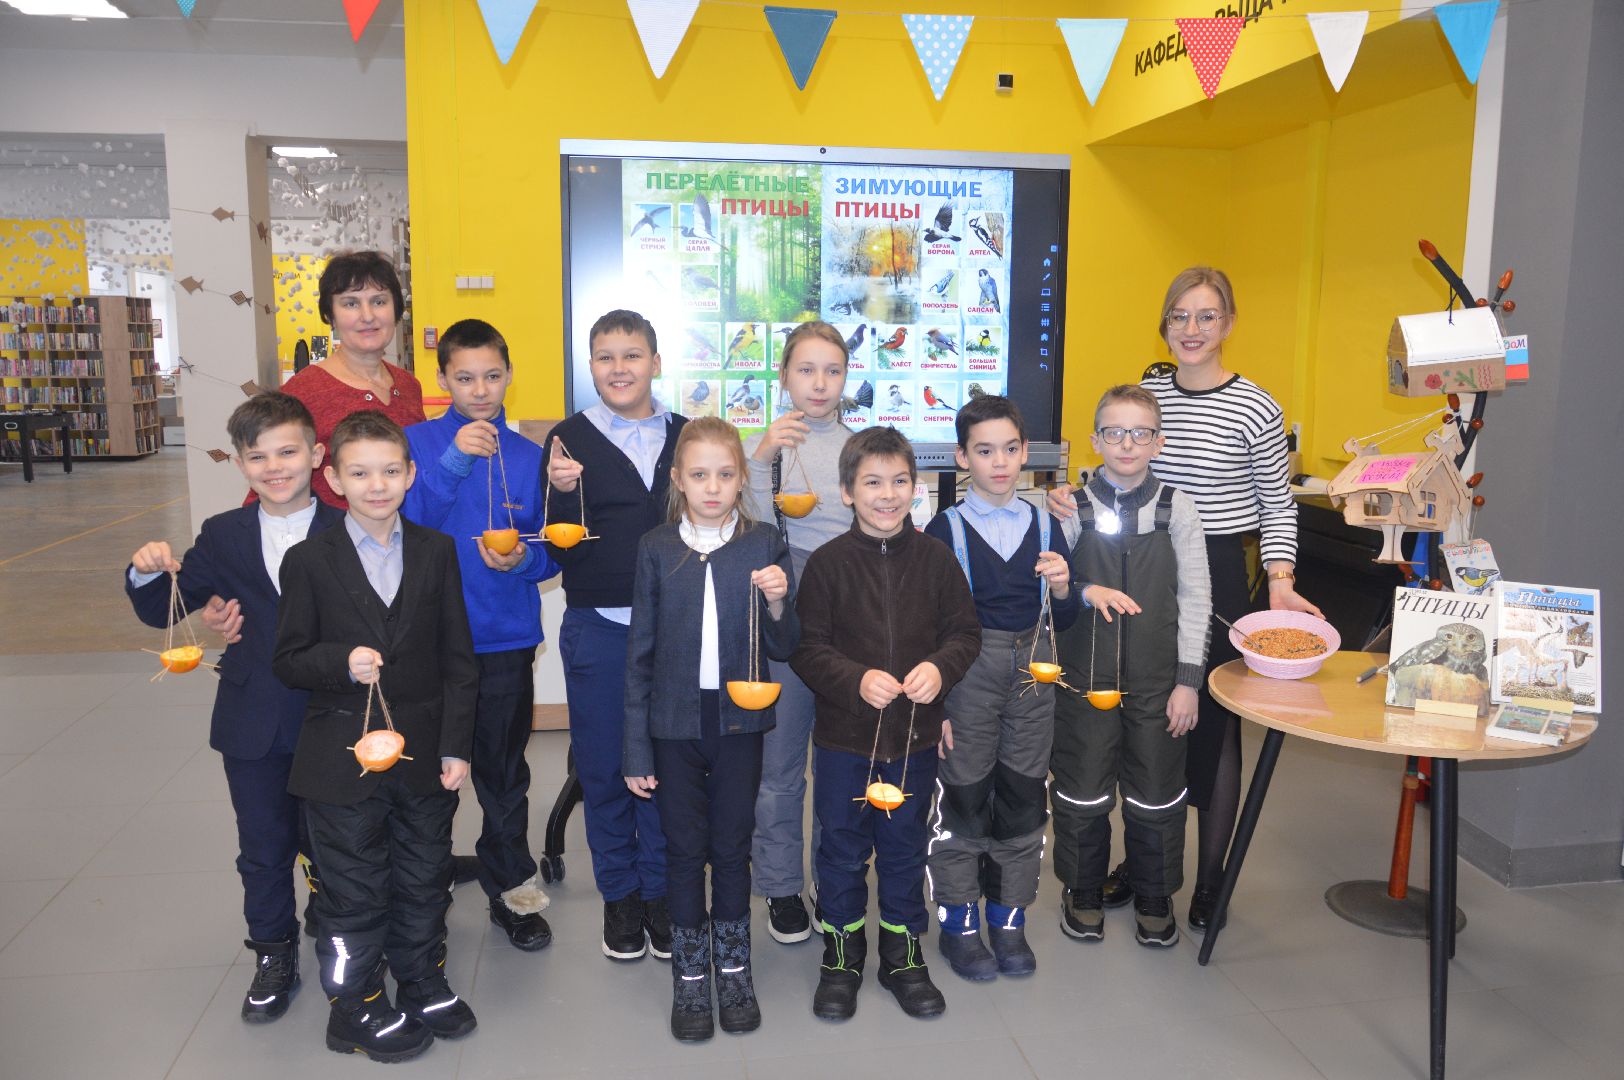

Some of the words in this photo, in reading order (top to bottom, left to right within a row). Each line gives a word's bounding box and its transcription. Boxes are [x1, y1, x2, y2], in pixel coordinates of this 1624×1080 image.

[1134, 31, 1188, 77] КАФЕД
[646, 171, 809, 193] ПЕРЕЛЁТНЫЕ
[835, 177, 983, 199] ЗИМУЮЩИЕ
[721, 198, 809, 219] ПТИЦЫ
[835, 200, 921, 222] ПТИЦЫ
[686, 245, 711, 253] ЦАПЛЯ
[878, 414, 910, 422] ВОРОБЕЙ
[1400, 595, 1490, 622] ПТИЦЫ
[1517, 591, 1582, 609] Птицы
